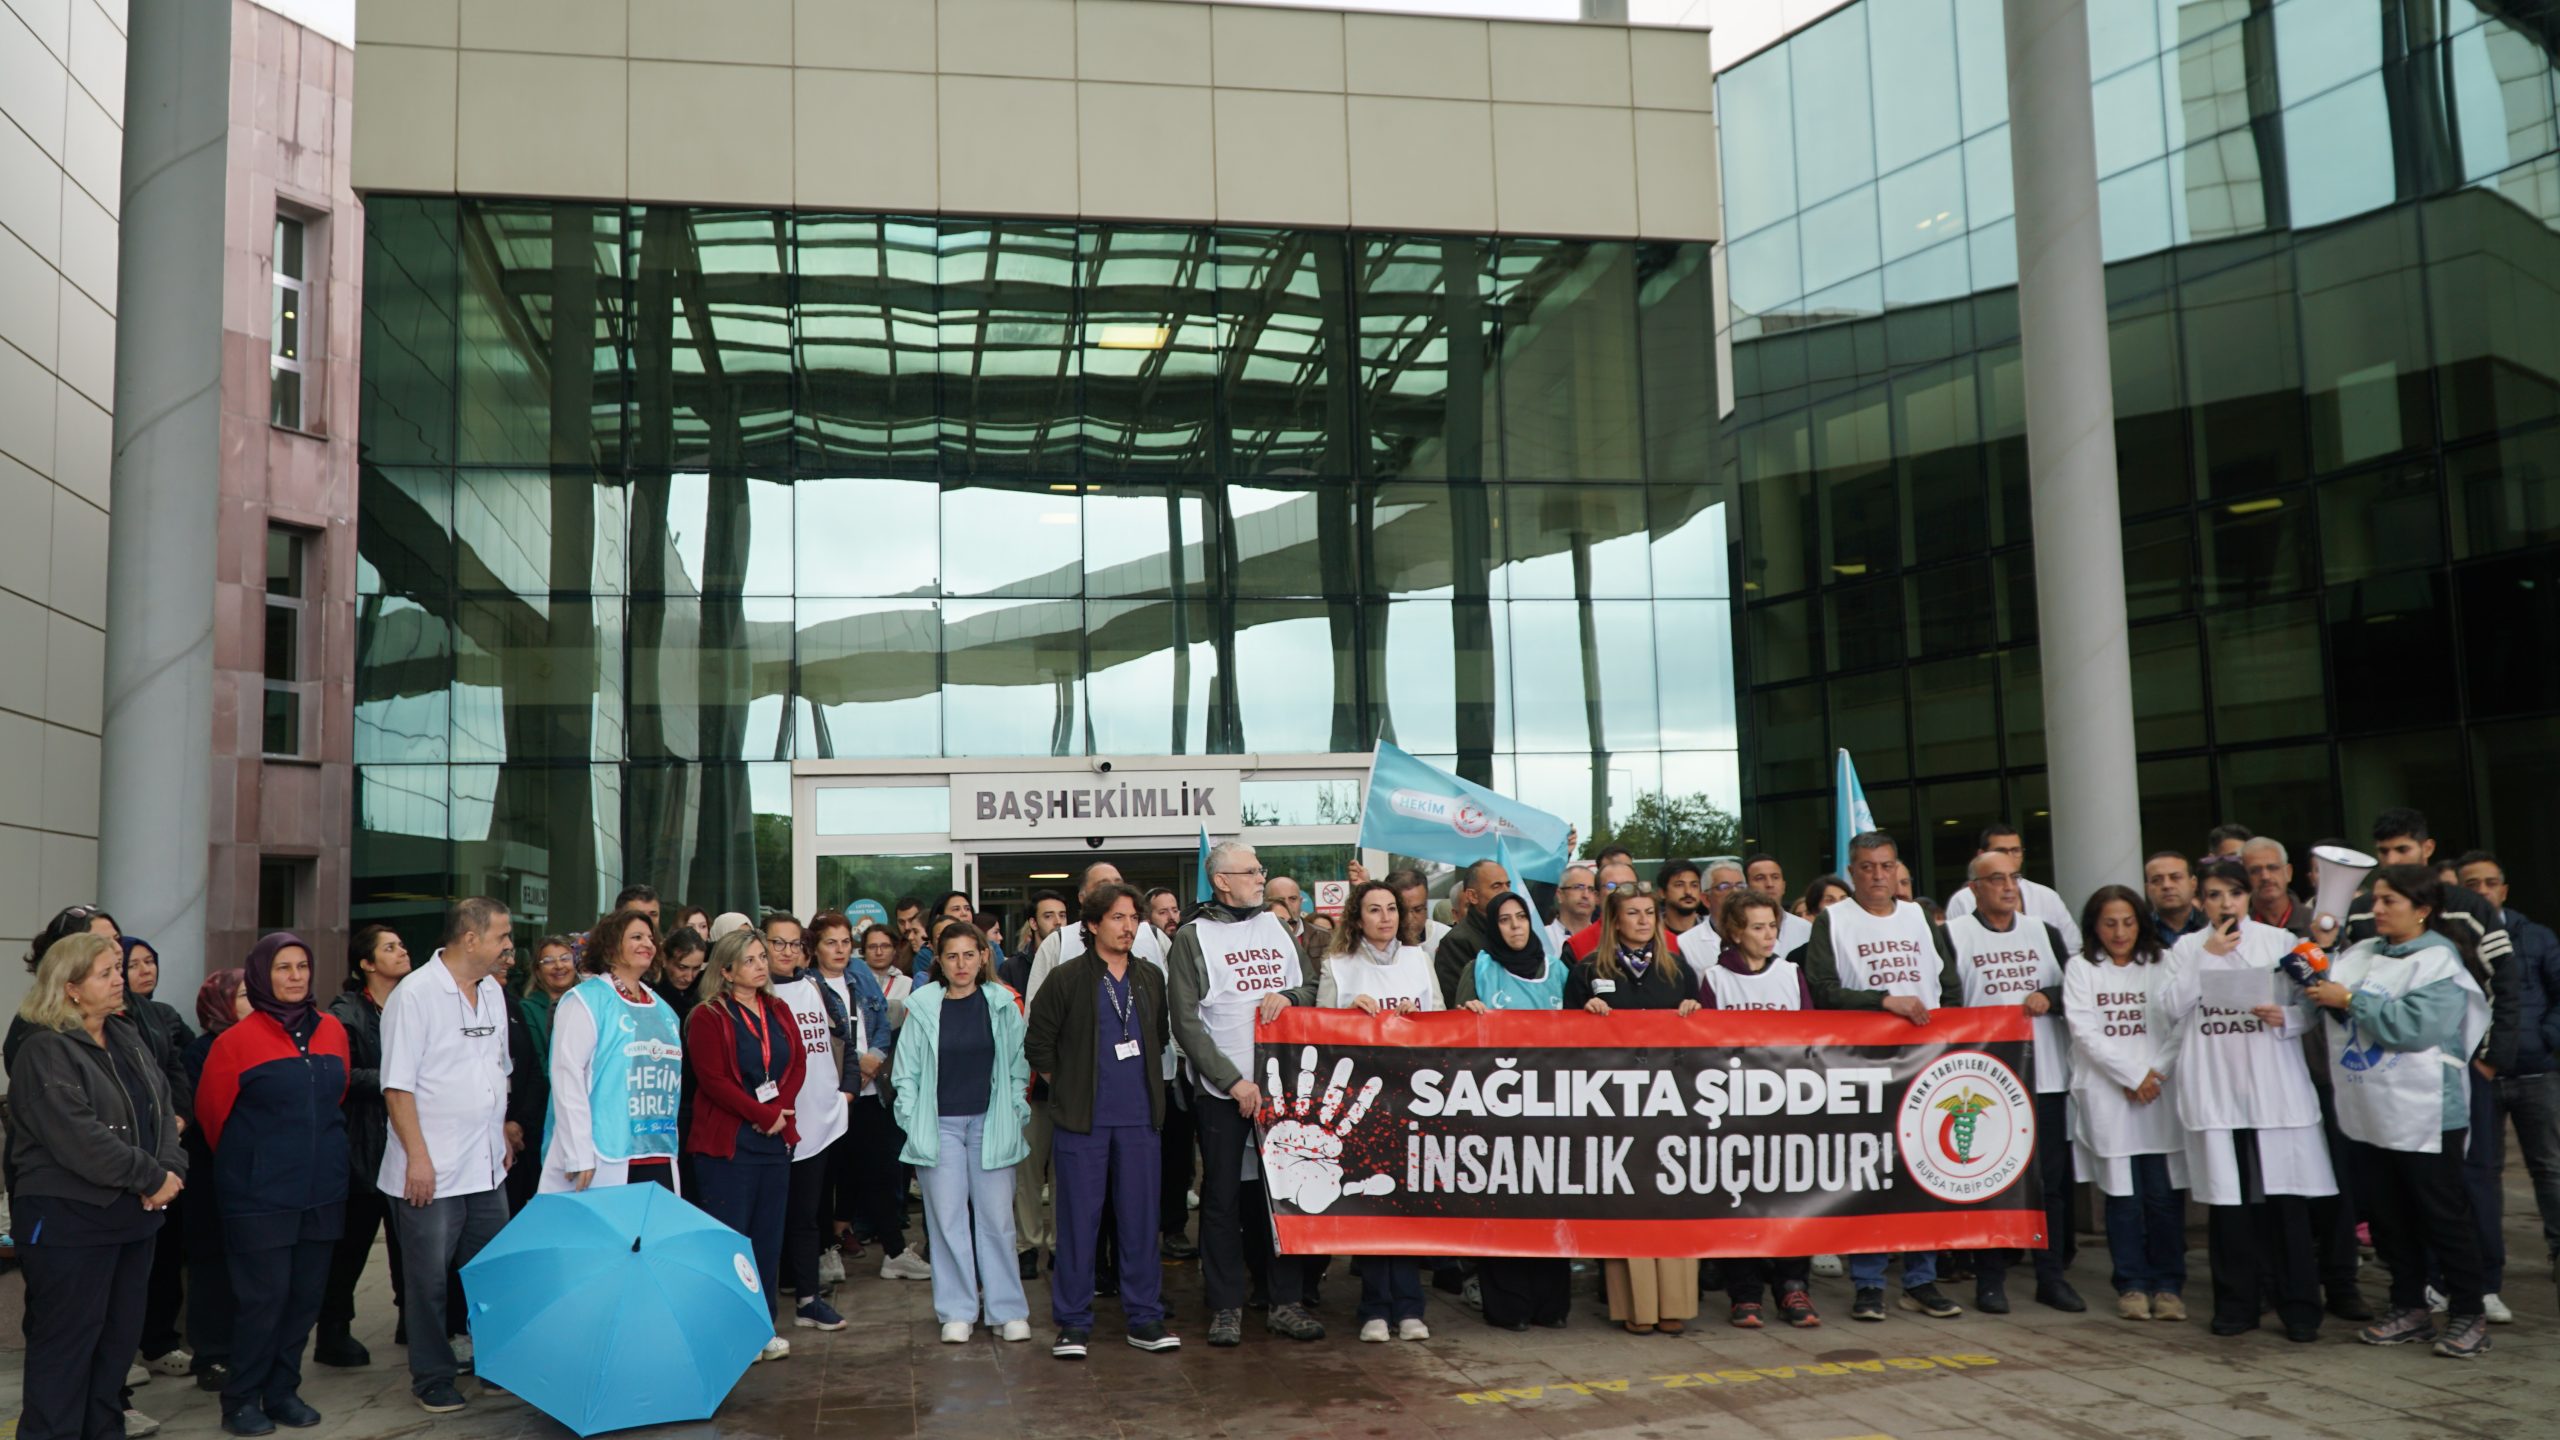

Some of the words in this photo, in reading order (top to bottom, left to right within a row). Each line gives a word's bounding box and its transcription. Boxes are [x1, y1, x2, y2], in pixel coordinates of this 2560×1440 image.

[976, 781, 1216, 827] BAŞHEKİMLİK
[1399, 797, 1445, 816] HEKİM
[1224, 948, 1284, 966] BURSA
[1858, 940, 1921, 957] BURSA
[1972, 949, 2041, 968] BURSA
[1234, 962, 1282, 978] TABİP
[1868, 970, 1921, 986] ODAS
[1982, 965, 2037, 980] TABİP
[1236, 975, 1287, 992] ODASI
[1984, 979, 2041, 995] ODASI
[2096, 991, 2146, 1007] BURS
[796, 1011, 826, 1025] RSA
[2104, 1010, 2142, 1022] TAB
[2104, 1024, 2146, 1037] ODA
[2200, 1019, 2264, 1036] ODASI
[807, 1041, 829, 1054] ASI
[1908, 1080, 1932, 1111] TÜRK
[1931, 1058, 1990, 1081] TABİPLERİ
[1990, 1067, 2026, 1108] BİRLİĞİ
[1407, 1058, 1688, 1117] SAĞLIKTA
[1693, 1057, 1893, 1130] ŞİDDET
[1407, 1121, 1635, 1195] İNSANLIK
[1656, 1132, 1894, 1208] SUÇUDUR!
[1916, 1159, 1947, 1190] BURSA
[1949, 1180, 1982, 1194] TABİP
[1983, 1156, 2019, 1188] ODASI
[1456, 1379, 1630, 1405] ALAN
